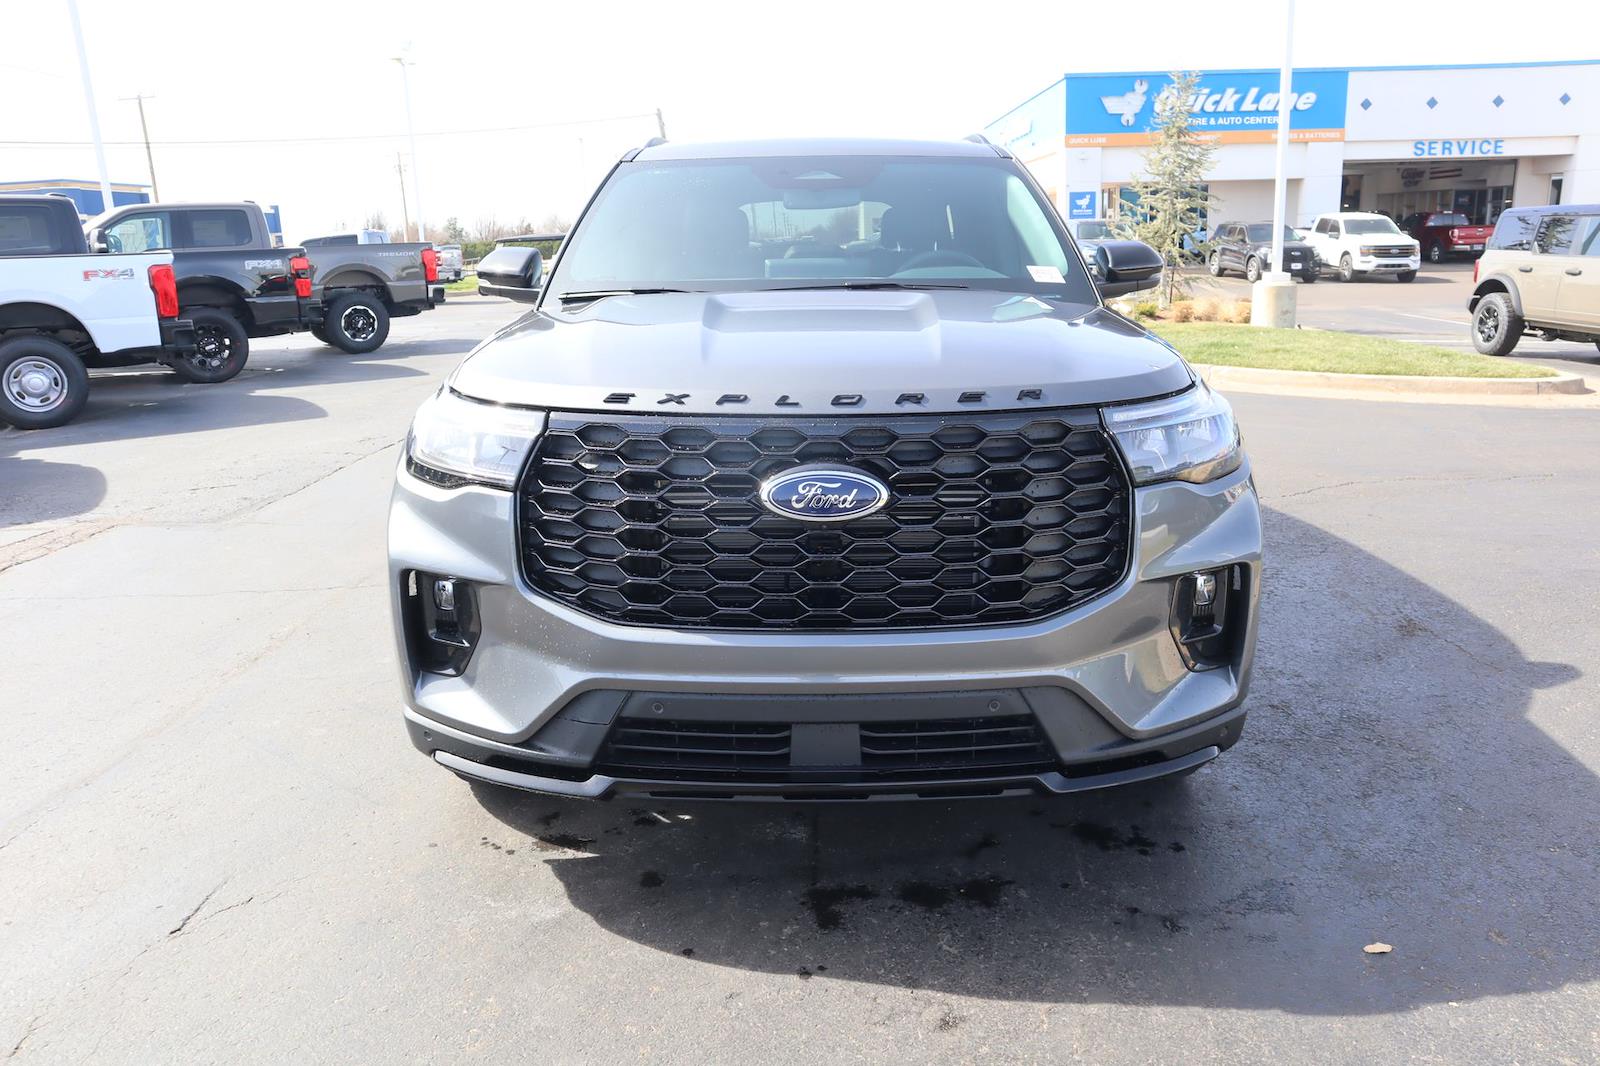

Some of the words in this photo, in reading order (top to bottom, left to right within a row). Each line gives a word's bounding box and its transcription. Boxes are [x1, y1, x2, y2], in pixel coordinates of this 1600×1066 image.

[1209, 117, 1216, 126] &
[1217, 116, 1243, 125] AUTO
[1243, 115, 1280, 124] CENTER
[1413, 139, 1505, 156] SERVICE
[244, 259, 283, 271] FX4
[82, 267, 135, 281] FX4
[603, 388, 1043, 407] EXPLORER
[791, 480, 859, 509] Ford
